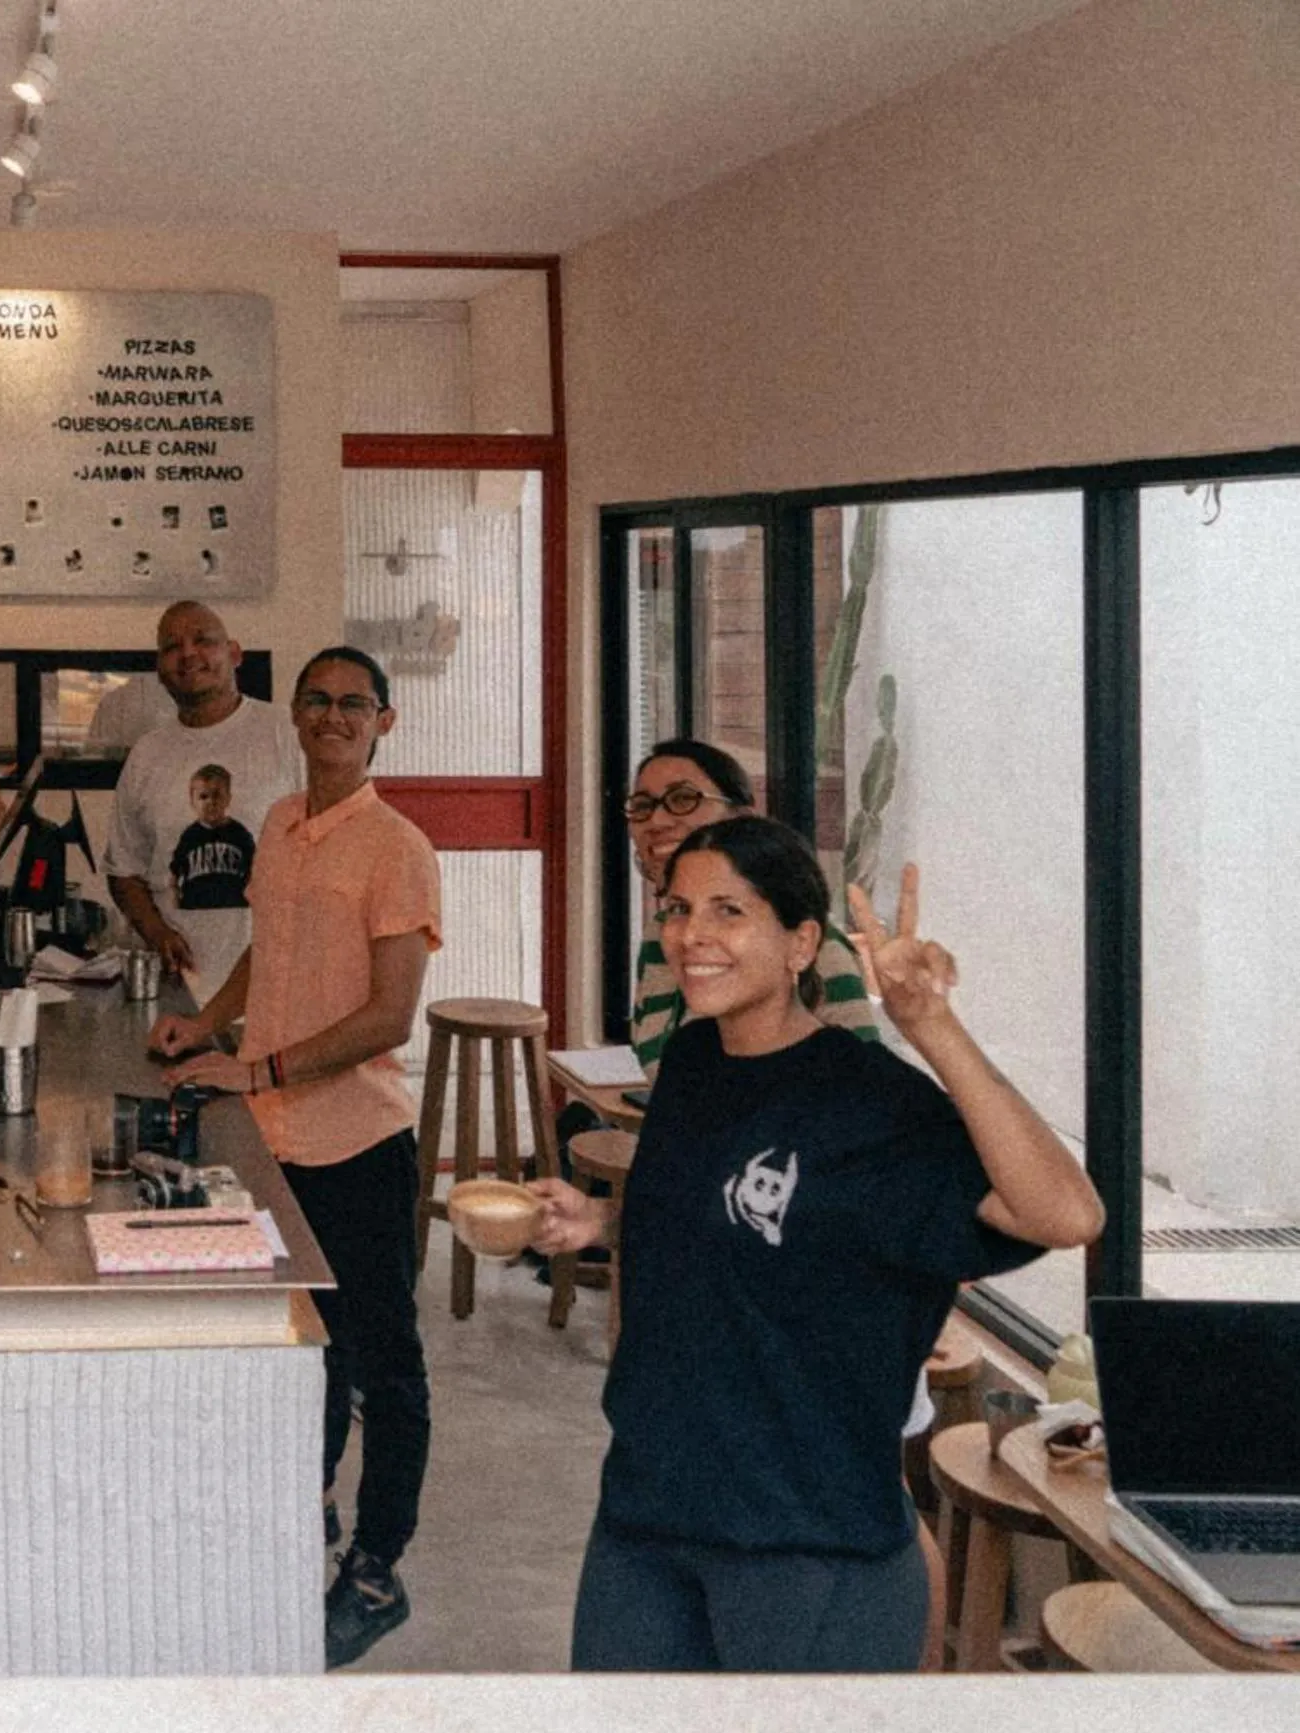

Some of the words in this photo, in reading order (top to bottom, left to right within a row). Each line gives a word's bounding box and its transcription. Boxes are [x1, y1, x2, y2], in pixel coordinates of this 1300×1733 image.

[124, 339, 196, 355] PIZZAS
[103, 364, 213, 381] MARINARA
[95, 389, 223, 406] MARGUERITA
[103, 440, 150, 456] ALLE
[157, 440, 217, 456] CARNI
[80, 465, 145, 481] JAMON
[156, 465, 244, 481] SERRANO
